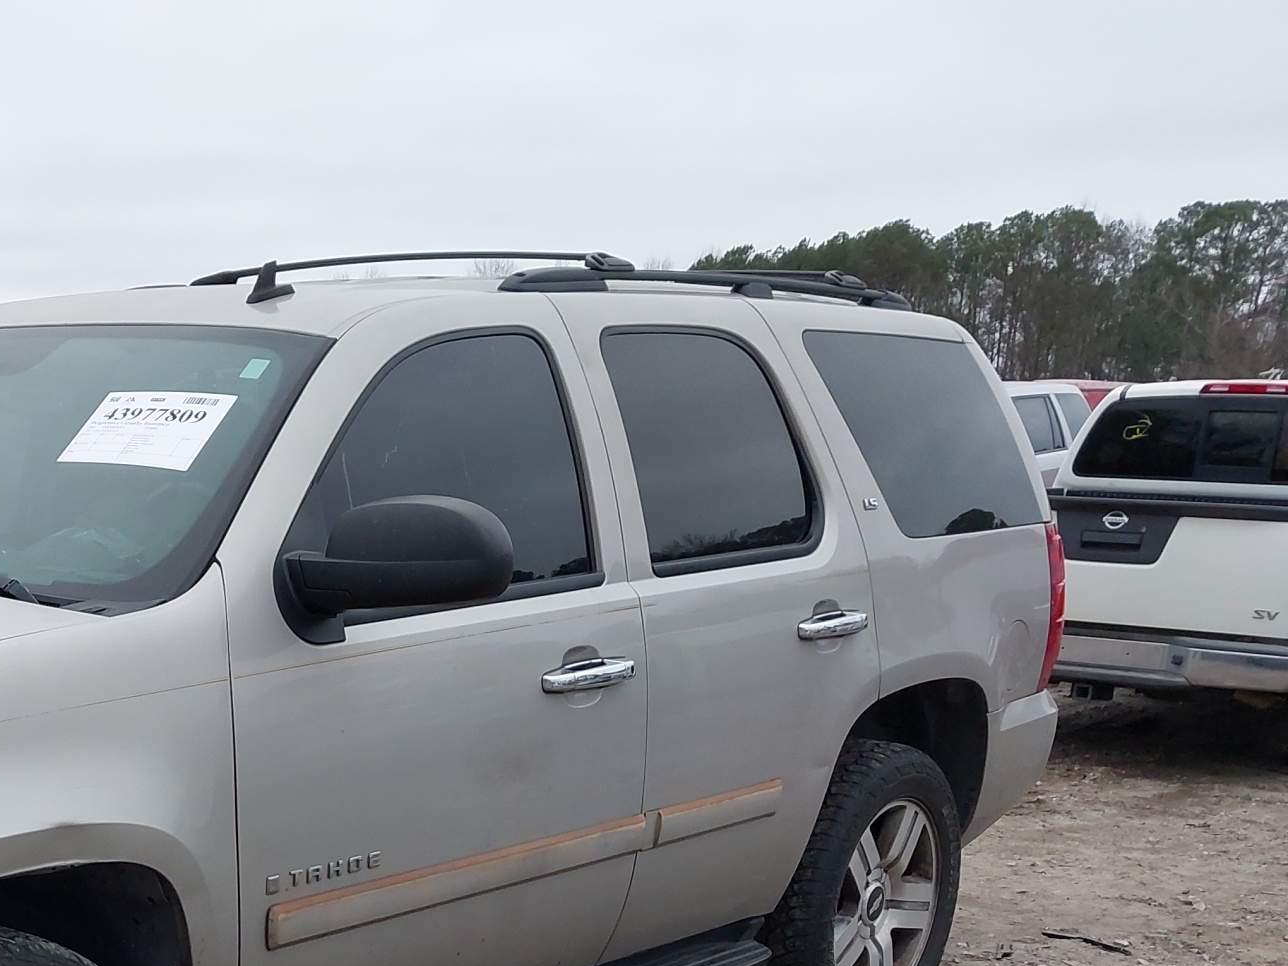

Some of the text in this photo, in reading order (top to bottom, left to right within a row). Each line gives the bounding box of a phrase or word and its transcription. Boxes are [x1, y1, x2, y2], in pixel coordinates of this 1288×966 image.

[103, 407, 208, 424] 43977809
[1252, 609, 1280, 621] SV
[289, 850, 381, 888] TAHOE
